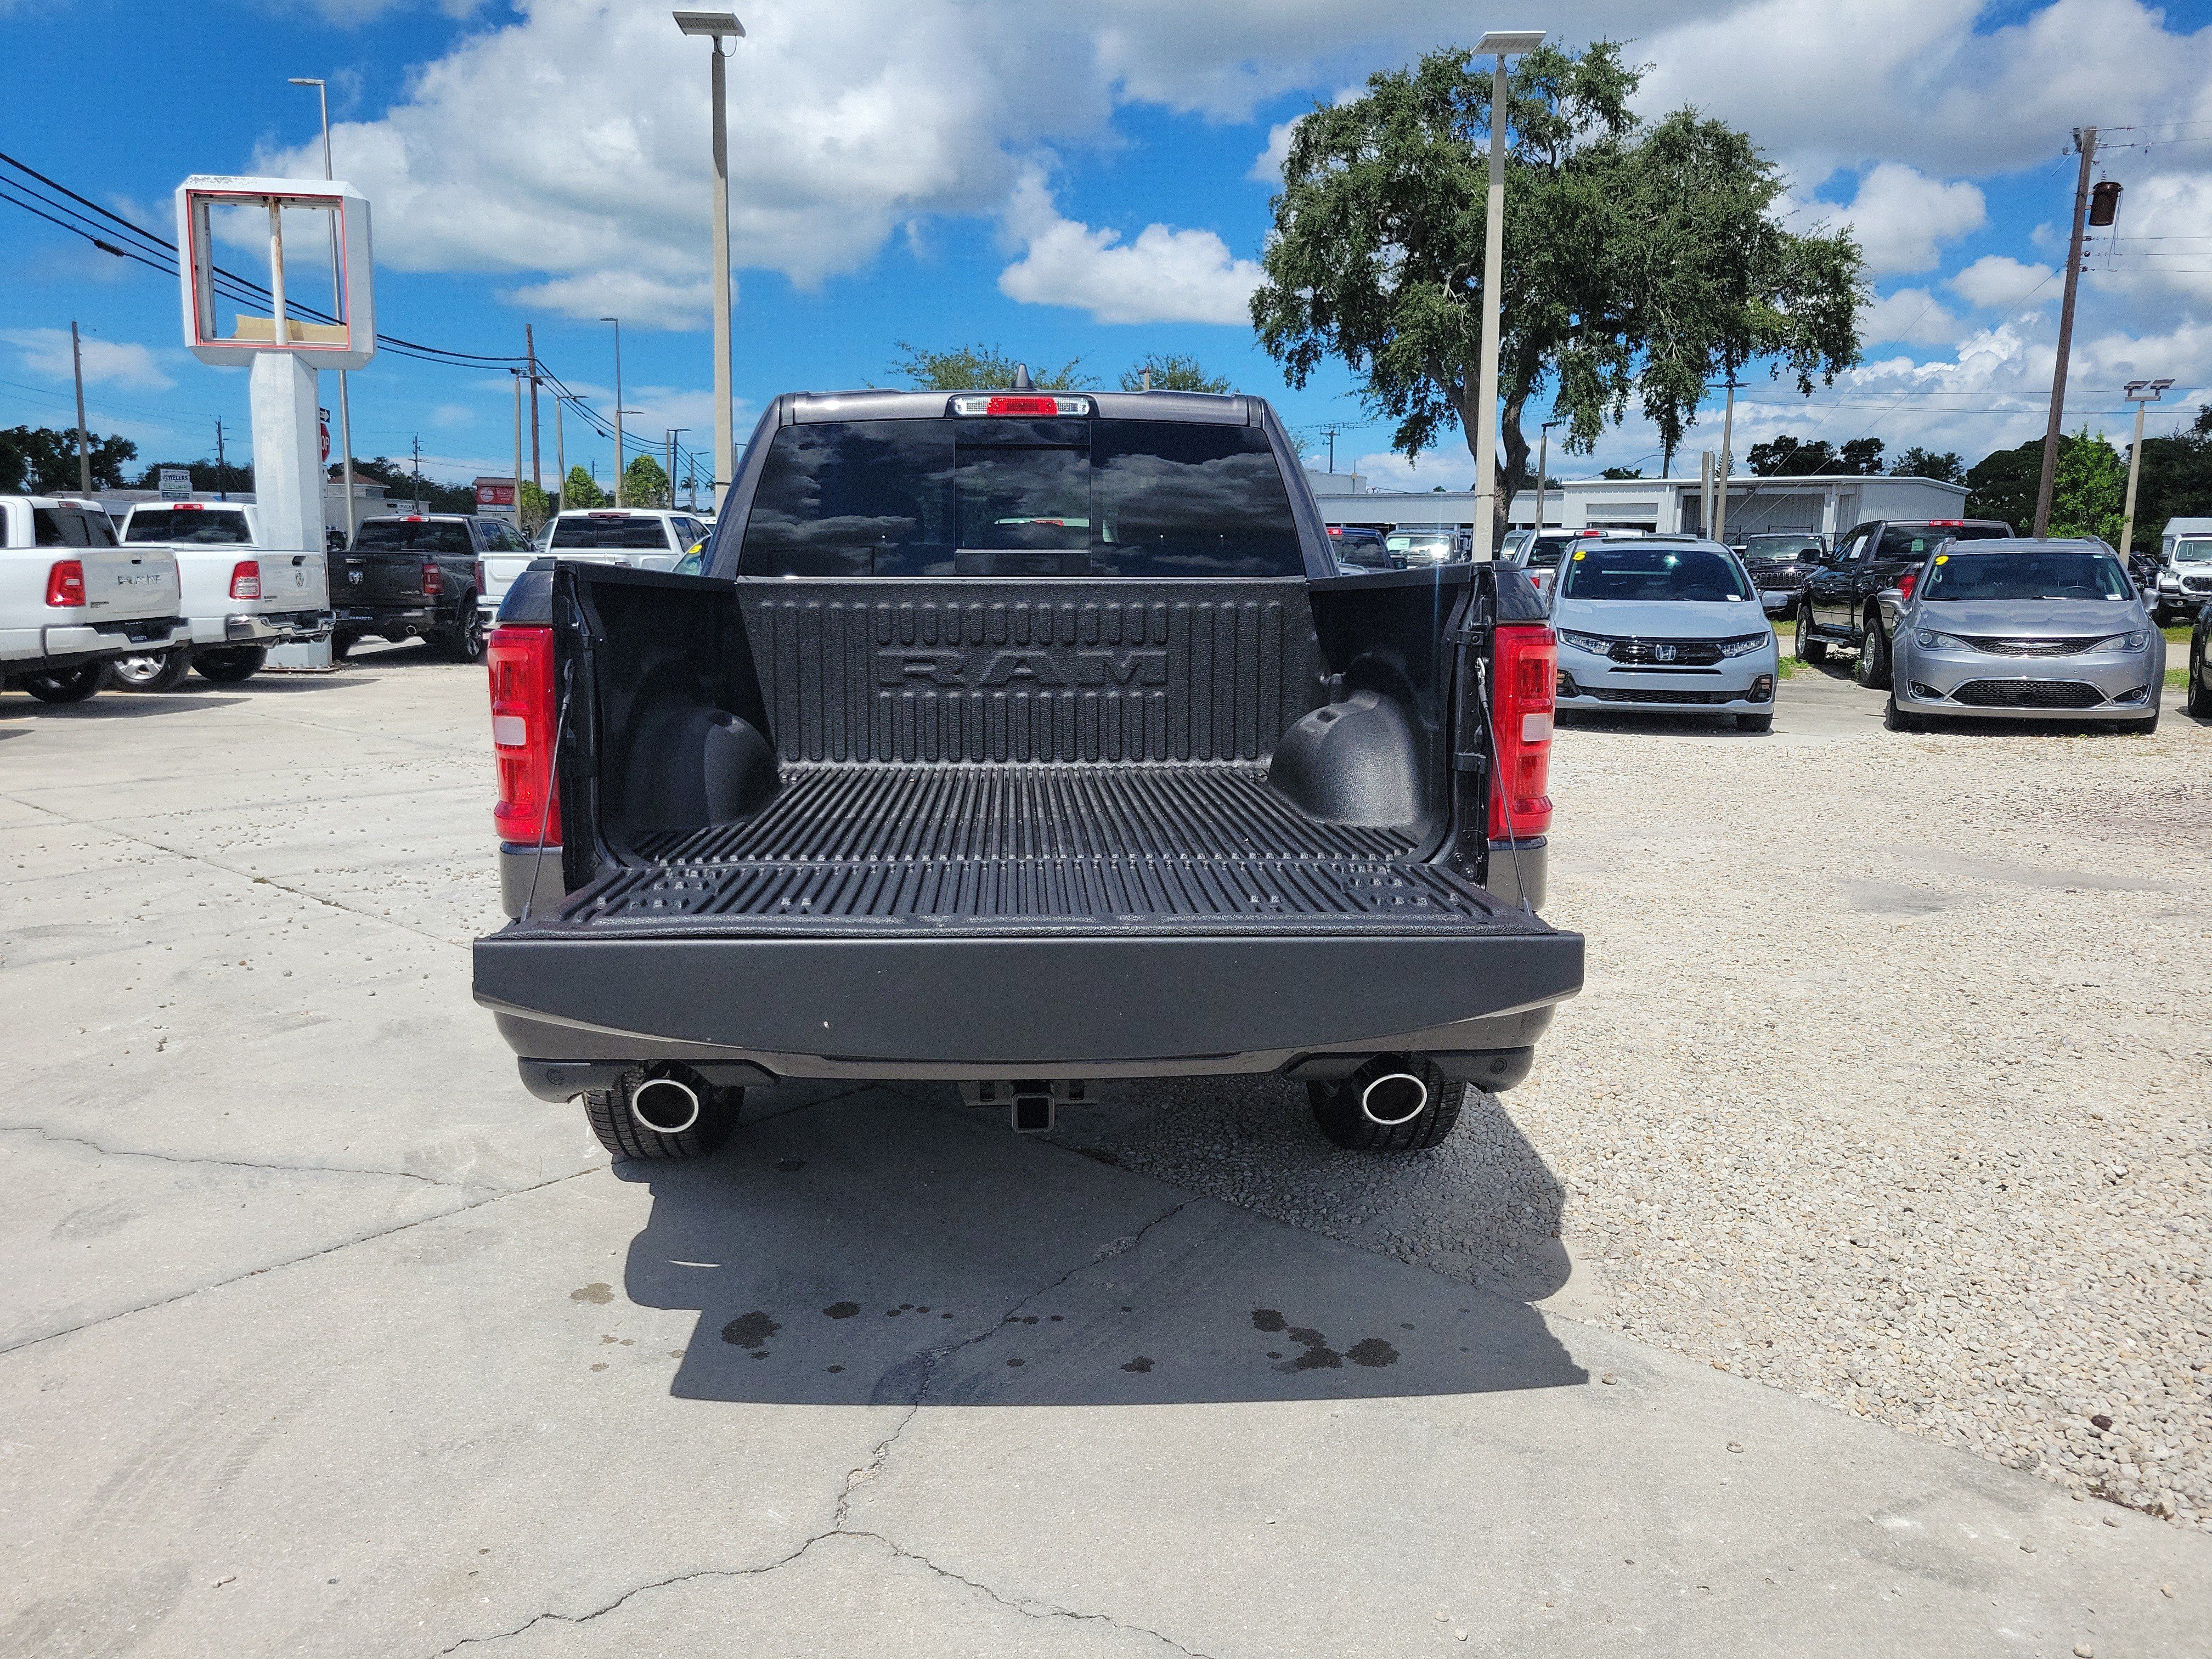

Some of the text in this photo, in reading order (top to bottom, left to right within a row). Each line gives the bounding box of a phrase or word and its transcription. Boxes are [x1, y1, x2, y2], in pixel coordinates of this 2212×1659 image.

[1573, 551, 1587, 561] 5
[1935, 556, 1949, 565] 9
[877, 651, 1167, 686] RAM
